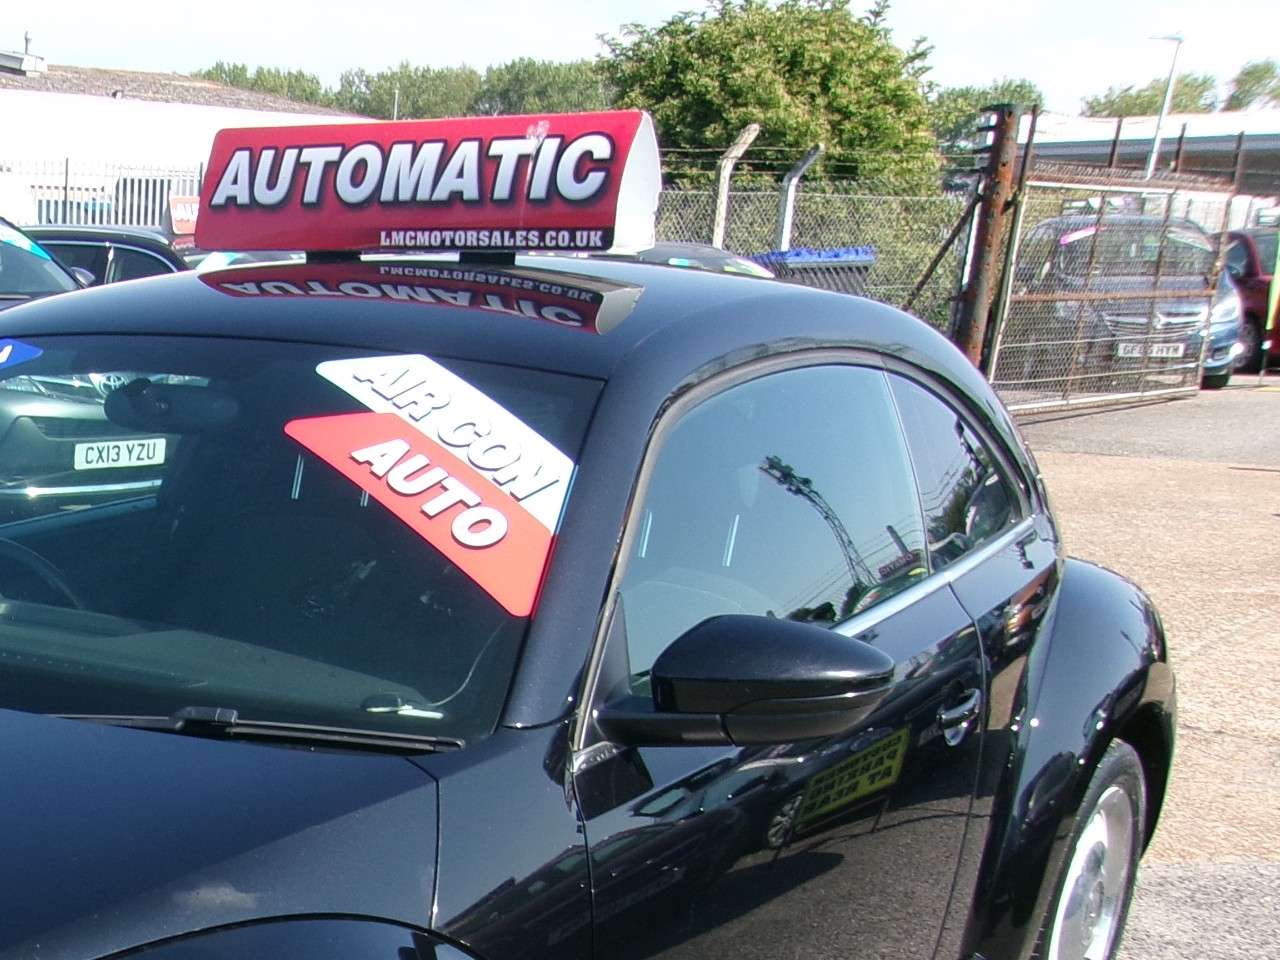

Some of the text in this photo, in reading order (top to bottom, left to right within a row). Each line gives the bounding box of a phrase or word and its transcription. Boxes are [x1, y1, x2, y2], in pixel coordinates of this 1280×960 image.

[210, 133, 613, 207] AUTOMATIC
[379, 229, 603, 248] LMCMOTORSALES.CO.UK
[85, 442, 157, 465] CX13 YZU
[353, 364, 560, 502] AIR CON
[349, 438, 509, 550] AUTO
